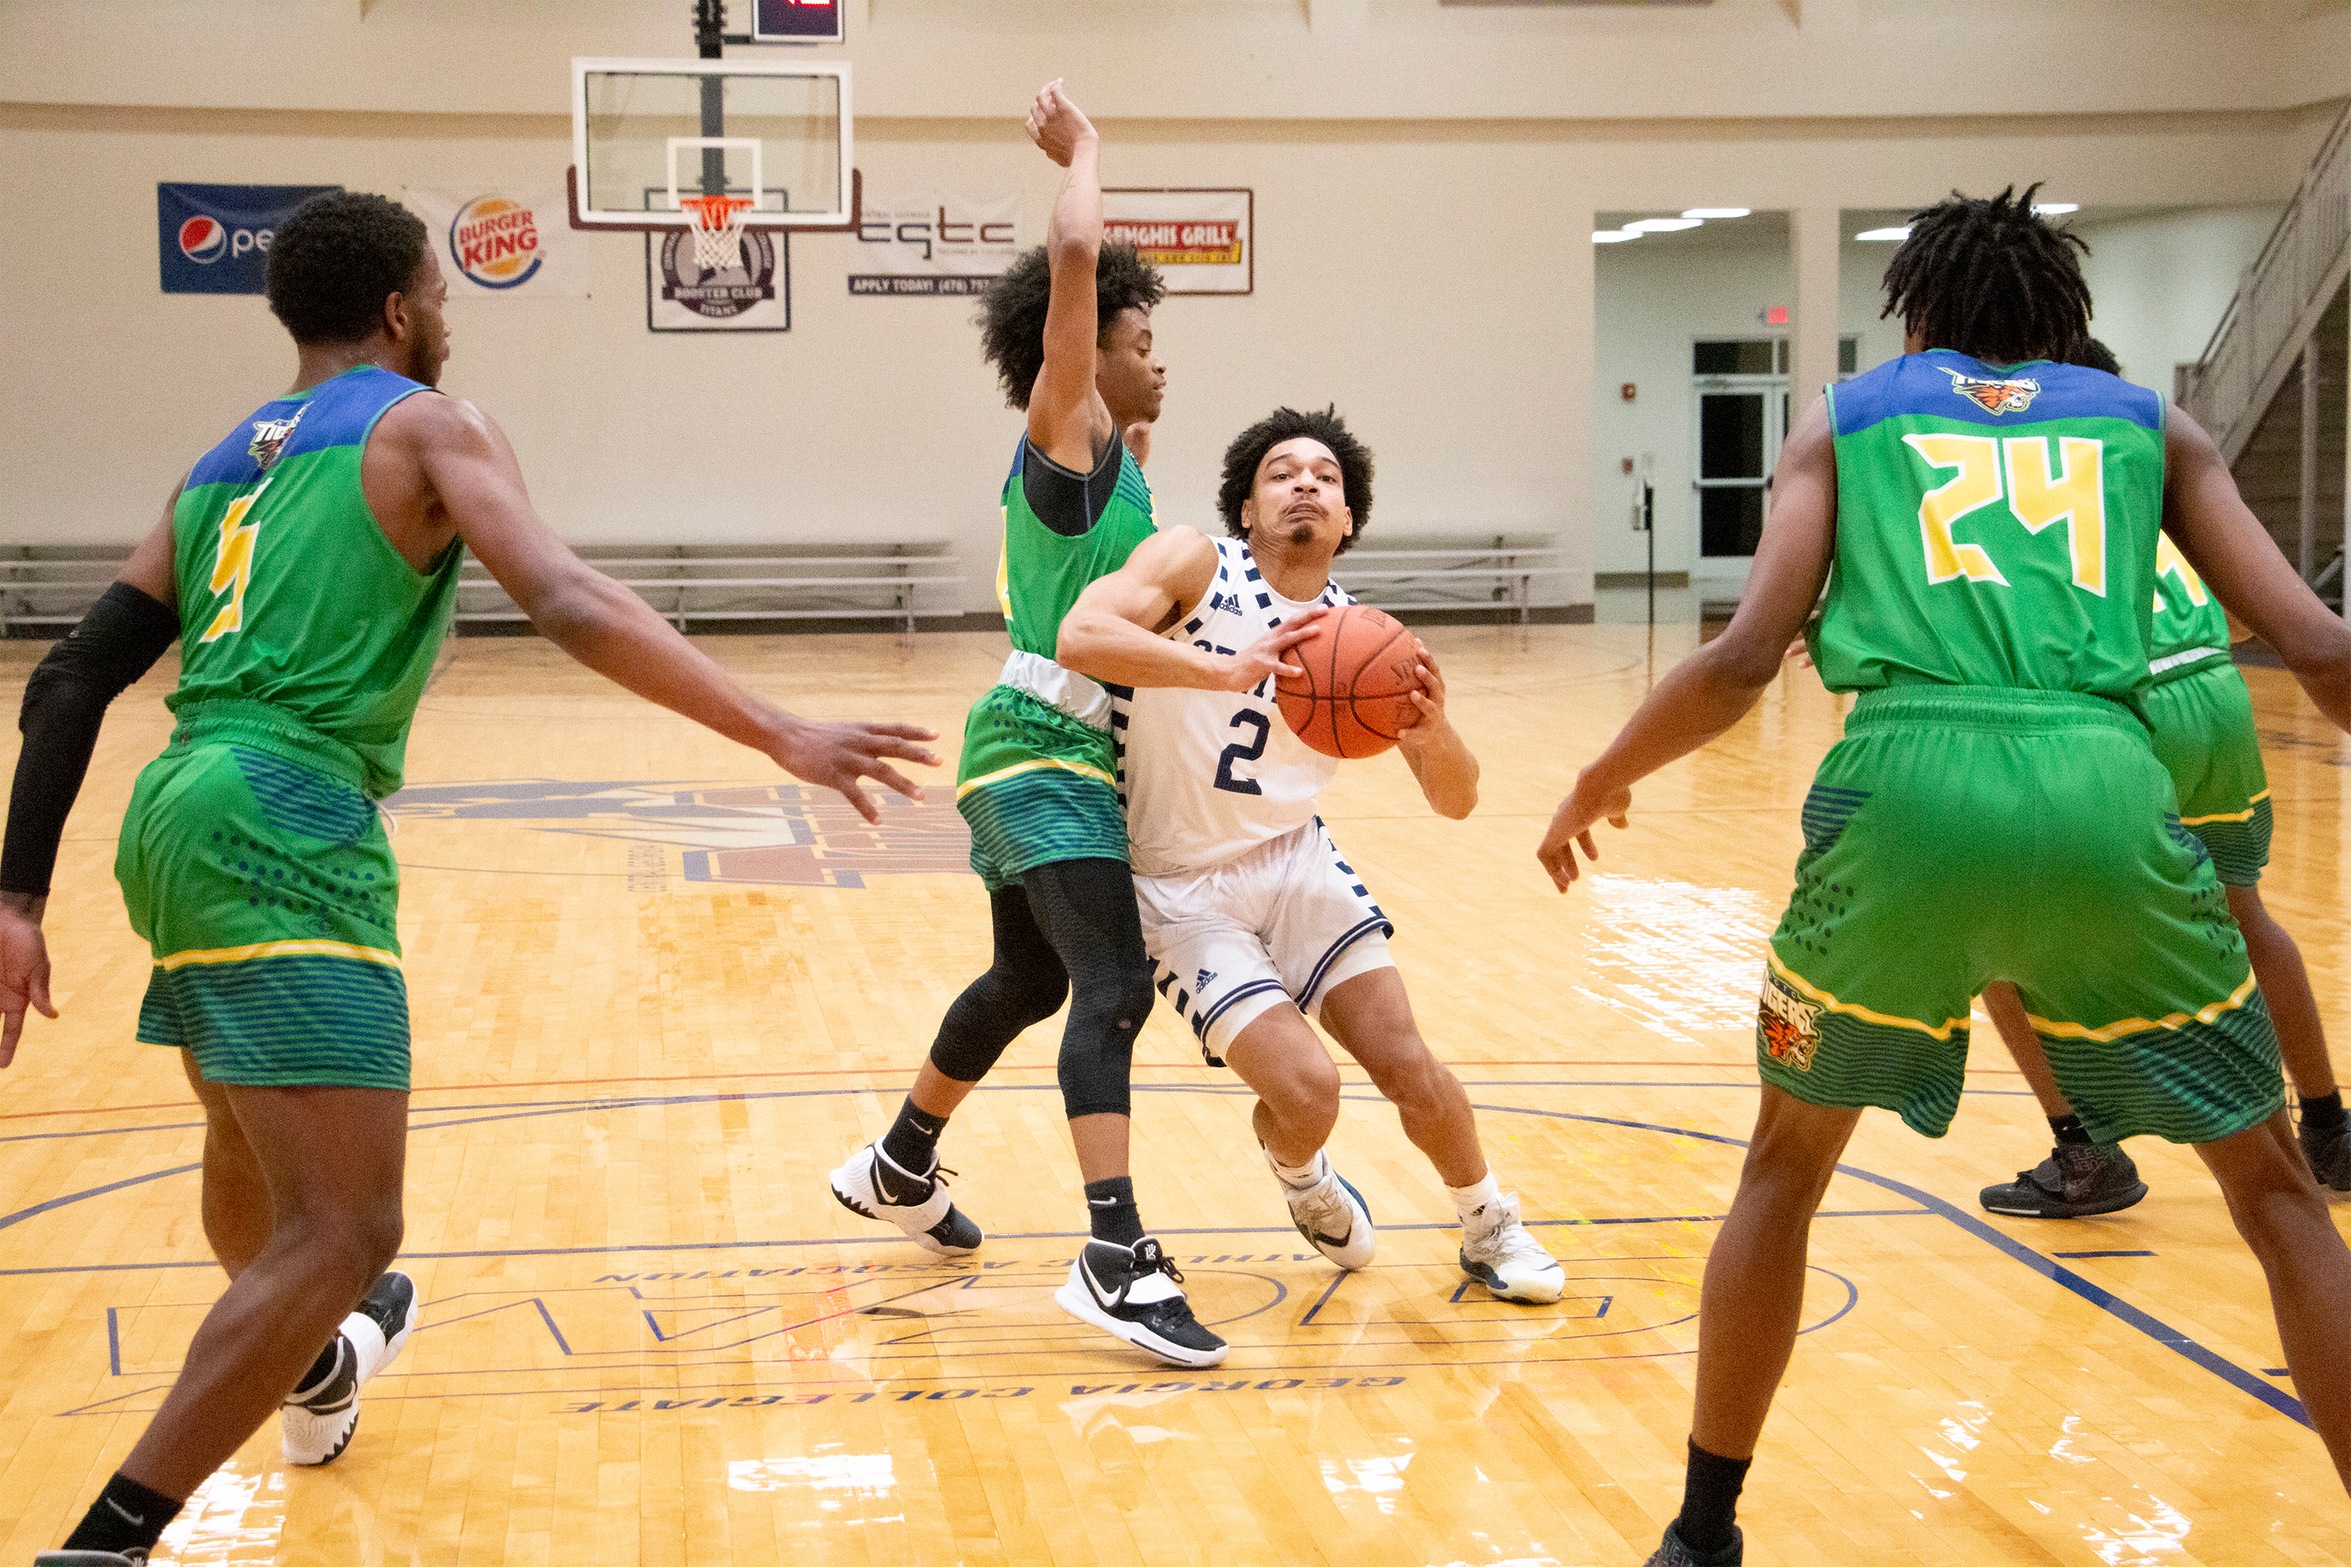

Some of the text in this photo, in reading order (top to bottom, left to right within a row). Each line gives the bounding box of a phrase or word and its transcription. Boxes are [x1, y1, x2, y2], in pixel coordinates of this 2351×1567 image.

[460, 210, 533, 244] BURGER
[1181, 225, 1230, 246] GRILL
[464, 228, 538, 270] KING
[675, 286, 763, 299] BOOSTER CLUB
[853, 279, 890, 293] APPLY
[1901, 433, 2106, 598] 24
[1219, 602, 1243, 617] adidas
[1213, 708, 1271, 796] 2
[1196, 971, 1218, 994] adidas
[593, 1254, 1322, 1283] ATHLC ASSOCIATION
[549, 1375, 1406, 1415] GEORGIA COLLEGIATE
